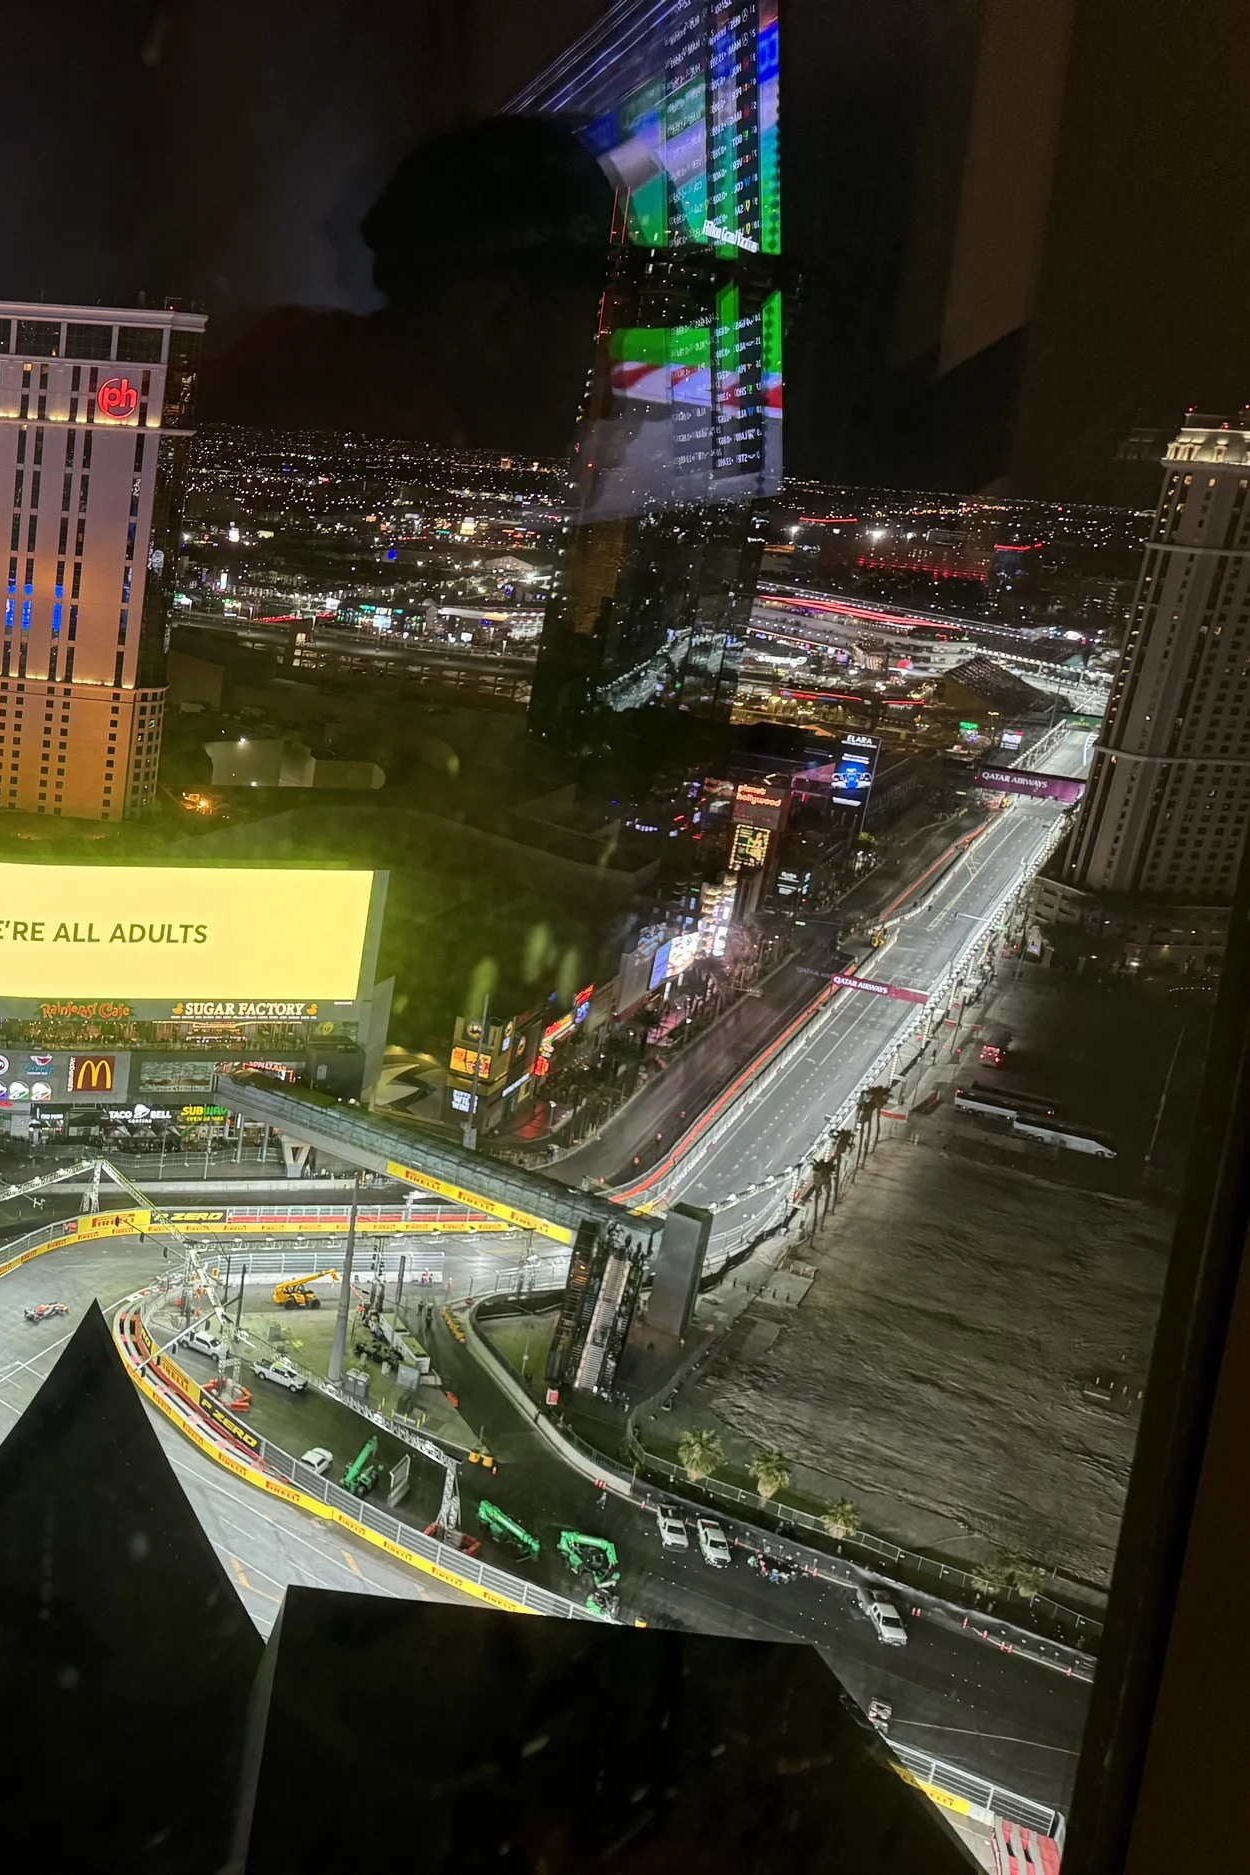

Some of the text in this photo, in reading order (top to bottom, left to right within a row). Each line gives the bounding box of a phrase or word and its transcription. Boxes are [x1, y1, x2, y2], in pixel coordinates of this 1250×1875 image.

[846, 734, 873, 745] ELARA
[738, 784, 767, 796] planet
[981, 771, 1048, 789] QATAR AIRWAYS
[736, 791, 782, 808] hollywood
[52, 922, 100, 943] ALL
[108, 923, 209, 945] ADULTS
[833, 975, 857, 988] QATAR
[857, 981, 888, 995] AIRWAYS
[40, 1001, 98, 1021] Rainforest
[184, 1002, 306, 1016] SUGAR FACTORY
[109, 1110, 172, 1120] TACO BELL
[181, 1106, 229, 1117] SUBWAY
[404, 1170, 442, 1191] PIRELLI
[457, 1191, 495, 1212] PIRELLI
[166, 1212, 224, 1221] ZERO
[201, 1399, 258, 1448] P ZERO
[218, 1452, 247, 1477] PIRELLI
[265, 1480, 300, 1502] PIRELLI
[338, 1514, 366, 1536] PIRELLI
[384, 1540, 413, 1562] PIRELLI
[431, 1566, 463, 1587] PIRELLI
[483, 1591, 517, 1612] PIRELLI
